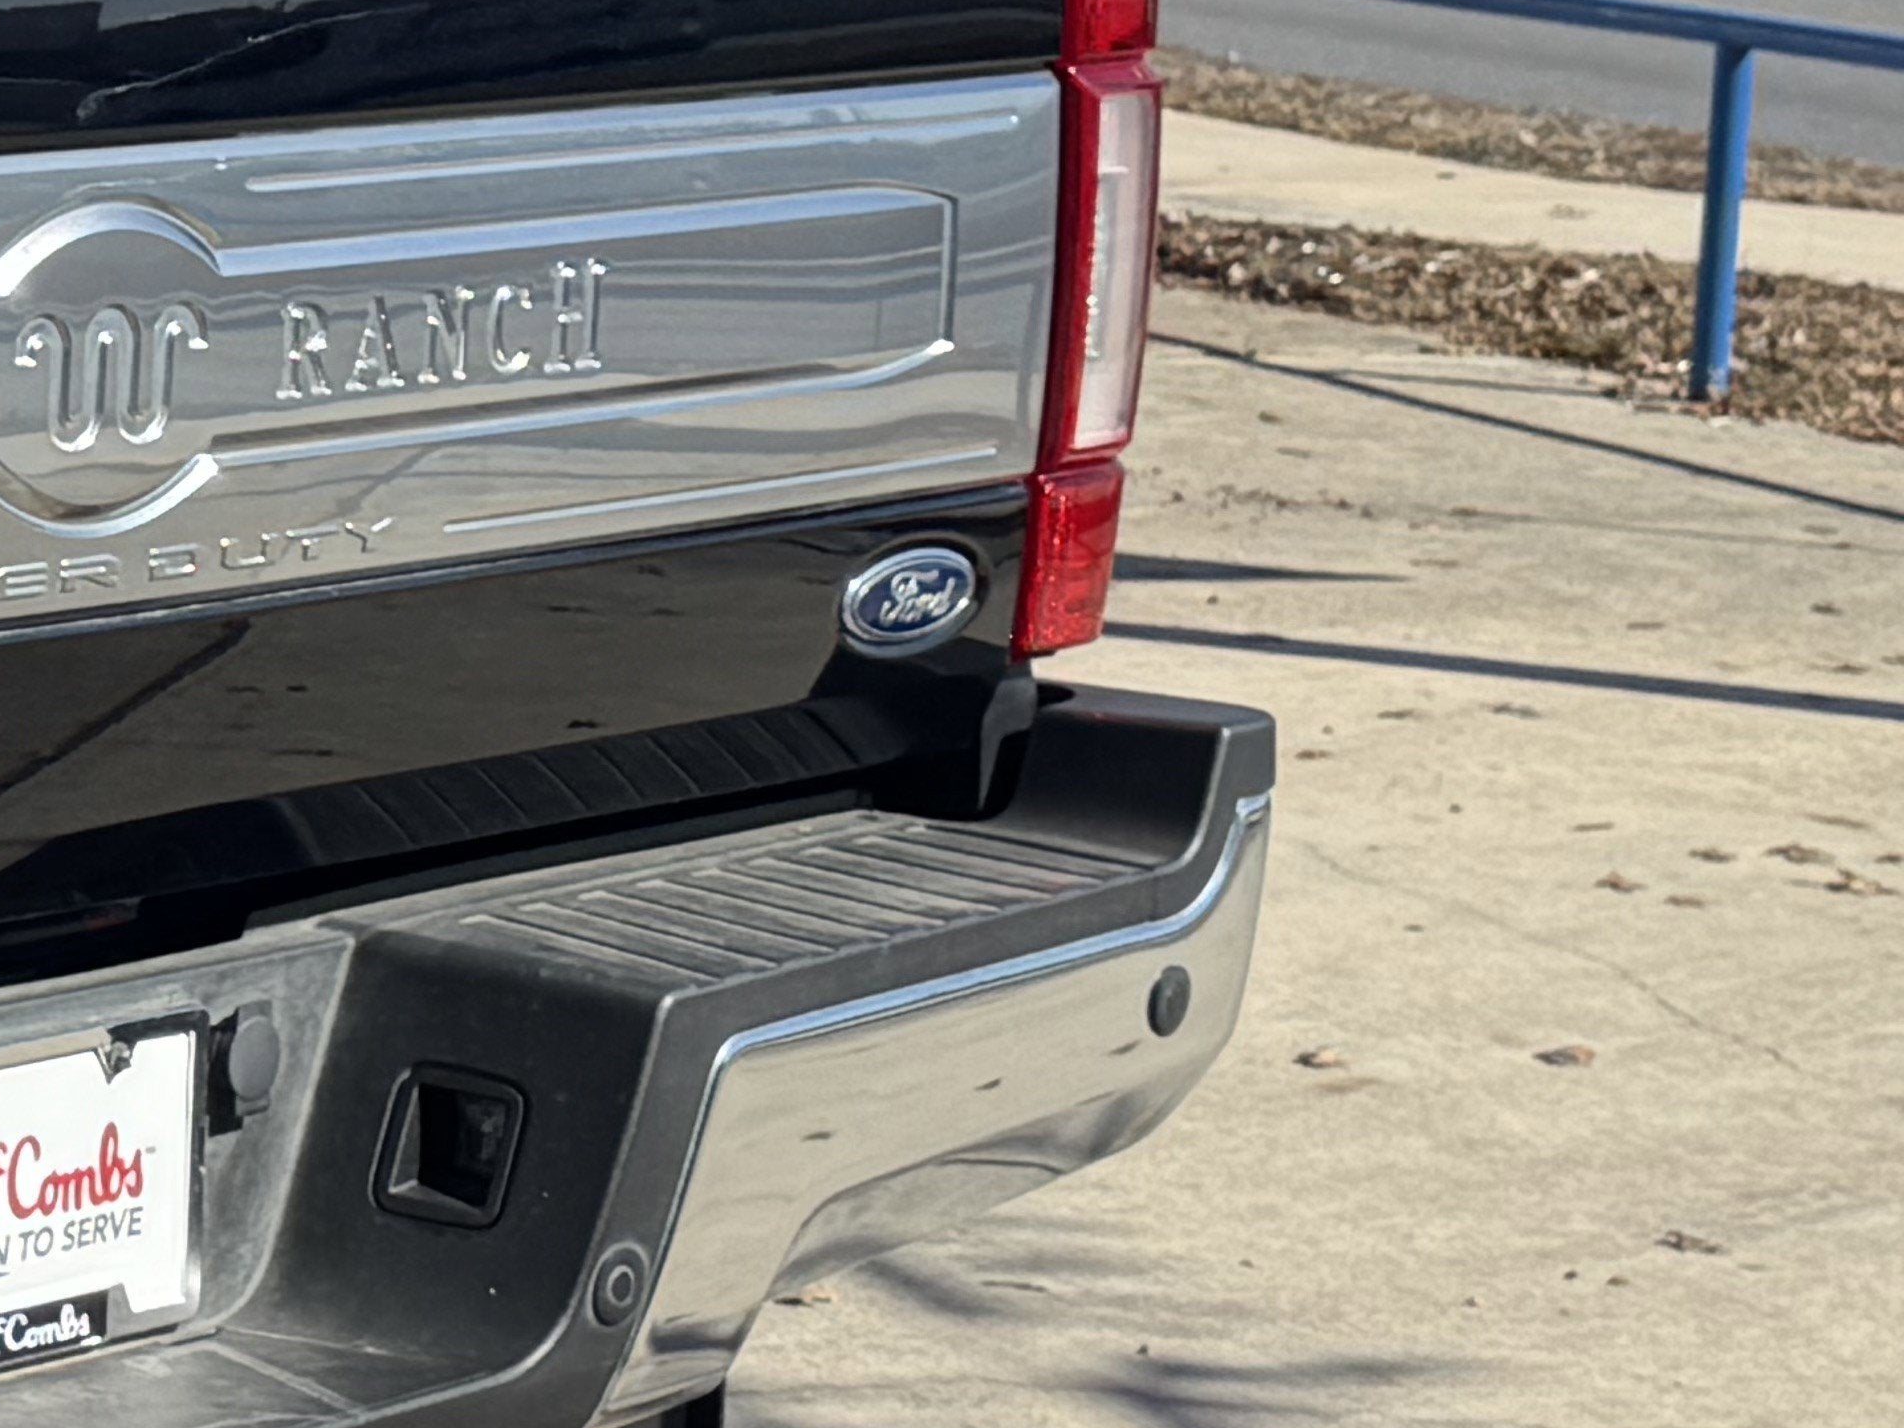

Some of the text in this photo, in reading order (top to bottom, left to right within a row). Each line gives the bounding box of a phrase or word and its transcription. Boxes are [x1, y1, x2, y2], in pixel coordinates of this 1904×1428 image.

[273, 256, 611, 400] RANCH
[148, 516, 395, 585] DUTY
[879, 569, 956, 627] Ford
[20, 1228, 55, 1259] TO
[61, 1205, 145, 1253] SERVE
